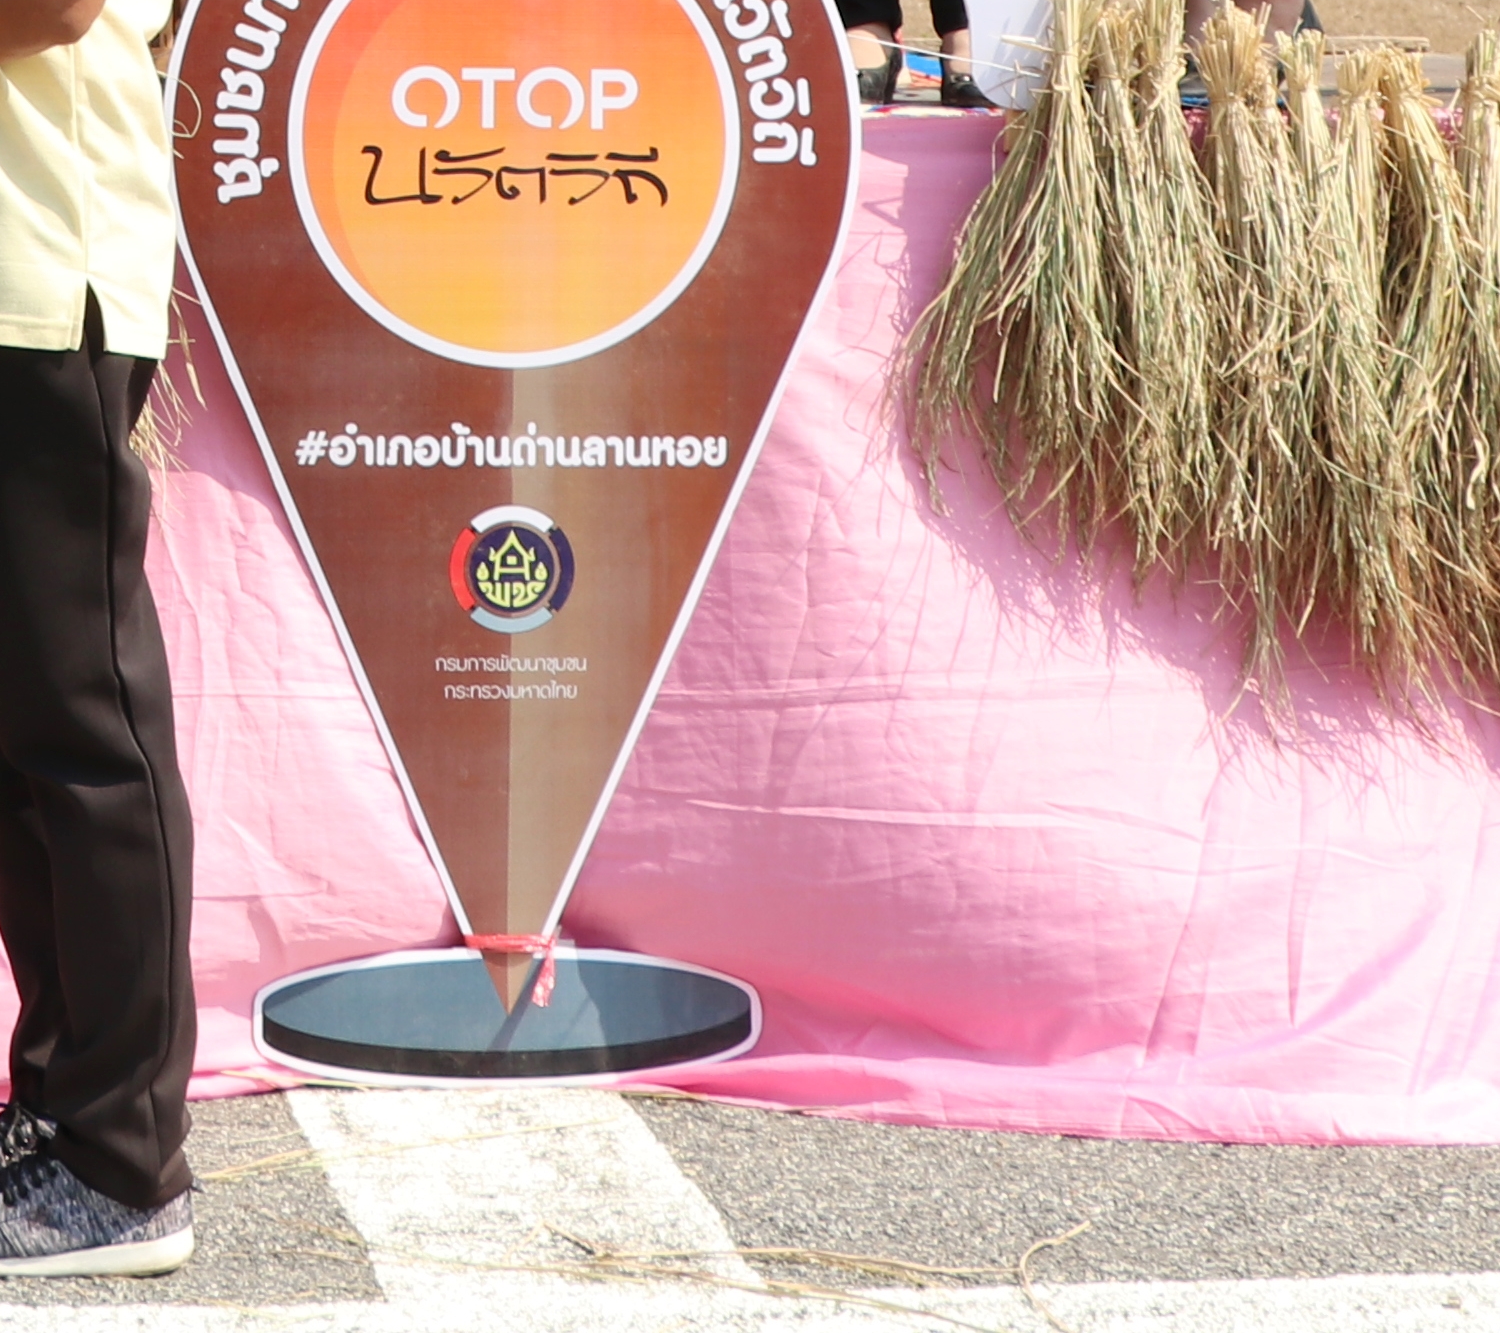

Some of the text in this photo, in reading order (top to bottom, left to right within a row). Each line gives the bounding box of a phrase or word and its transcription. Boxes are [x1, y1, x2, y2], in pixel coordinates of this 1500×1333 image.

[391, 65, 640, 130] OTOP
[295, 421, 728, 468] #อำเภอบ้านด่านลานหอย
[435, 654, 588, 675] กรมการพัฒนาชุมชน
[444, 679, 578, 701] กระทรวงมหาดไทย
